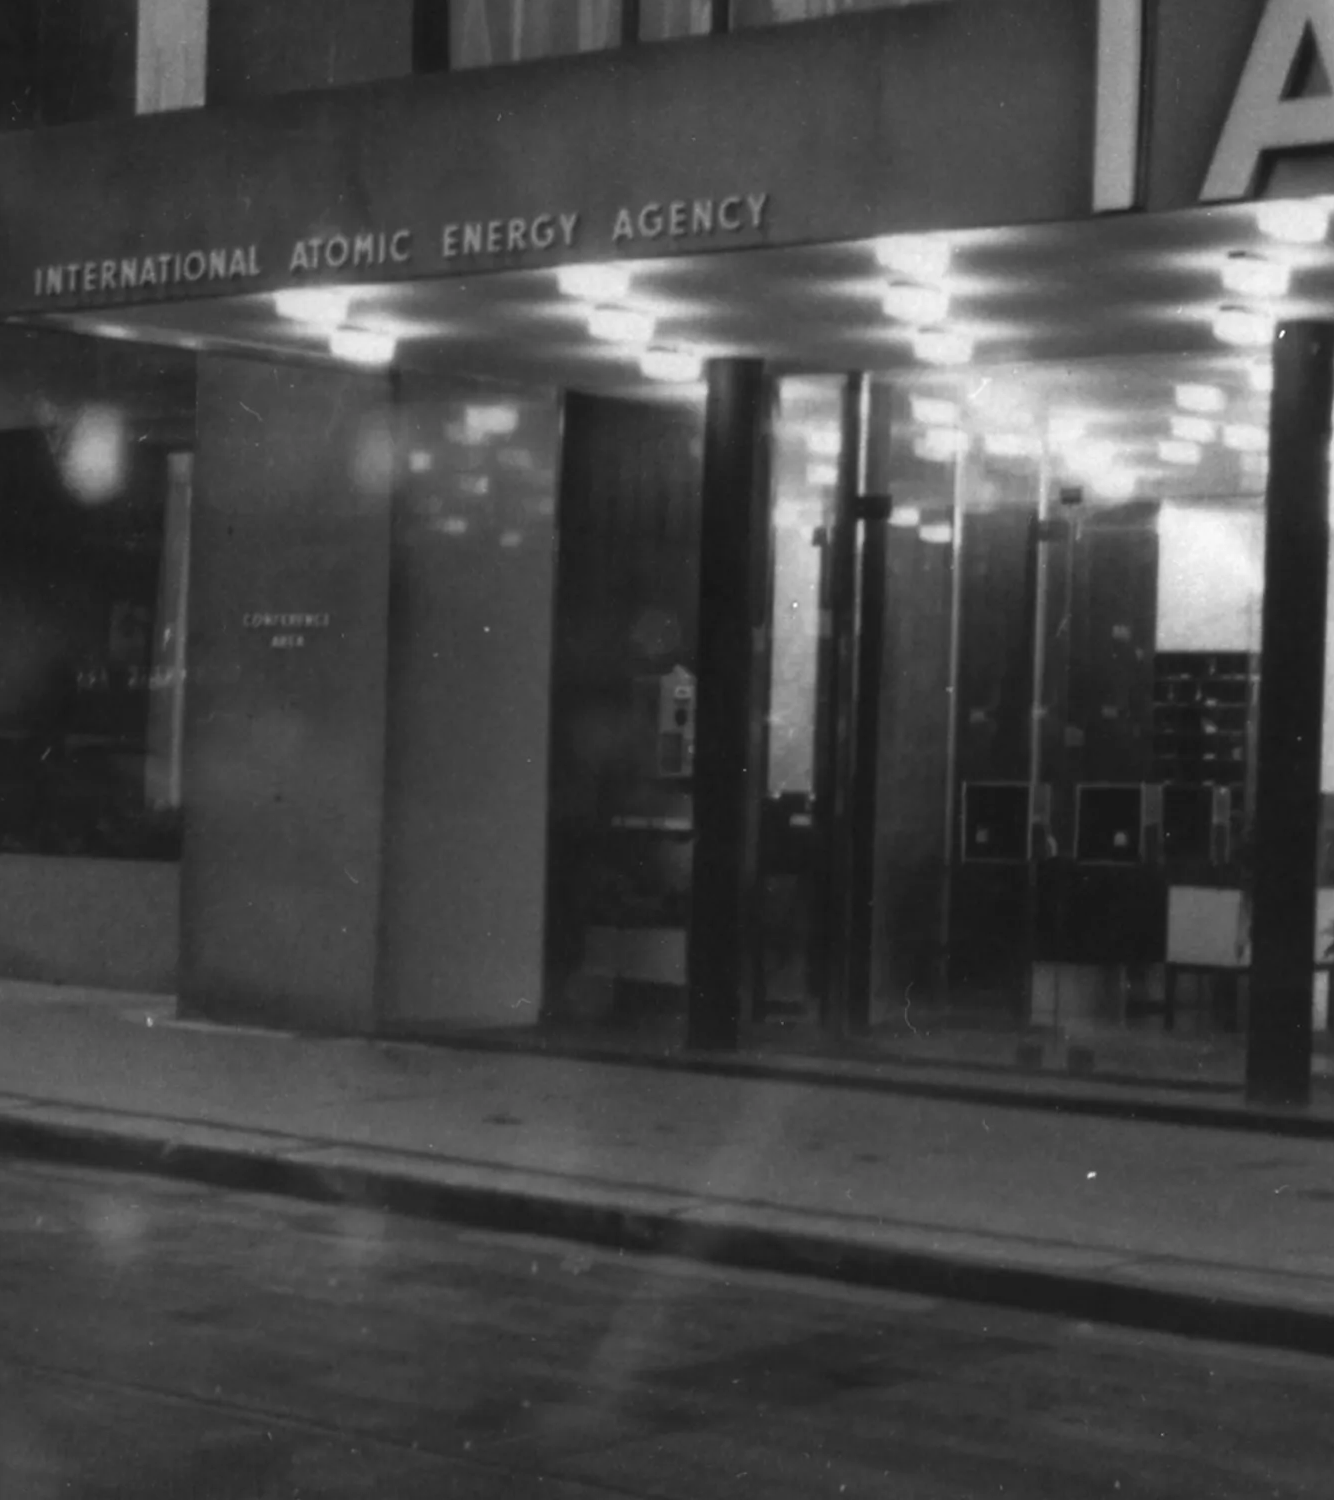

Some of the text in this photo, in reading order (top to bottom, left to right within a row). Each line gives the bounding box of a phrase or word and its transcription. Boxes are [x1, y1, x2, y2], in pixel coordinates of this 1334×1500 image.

[33, 193, 766, 296] INTERNATIONAL ATOMIC ENERGY AGENCY
